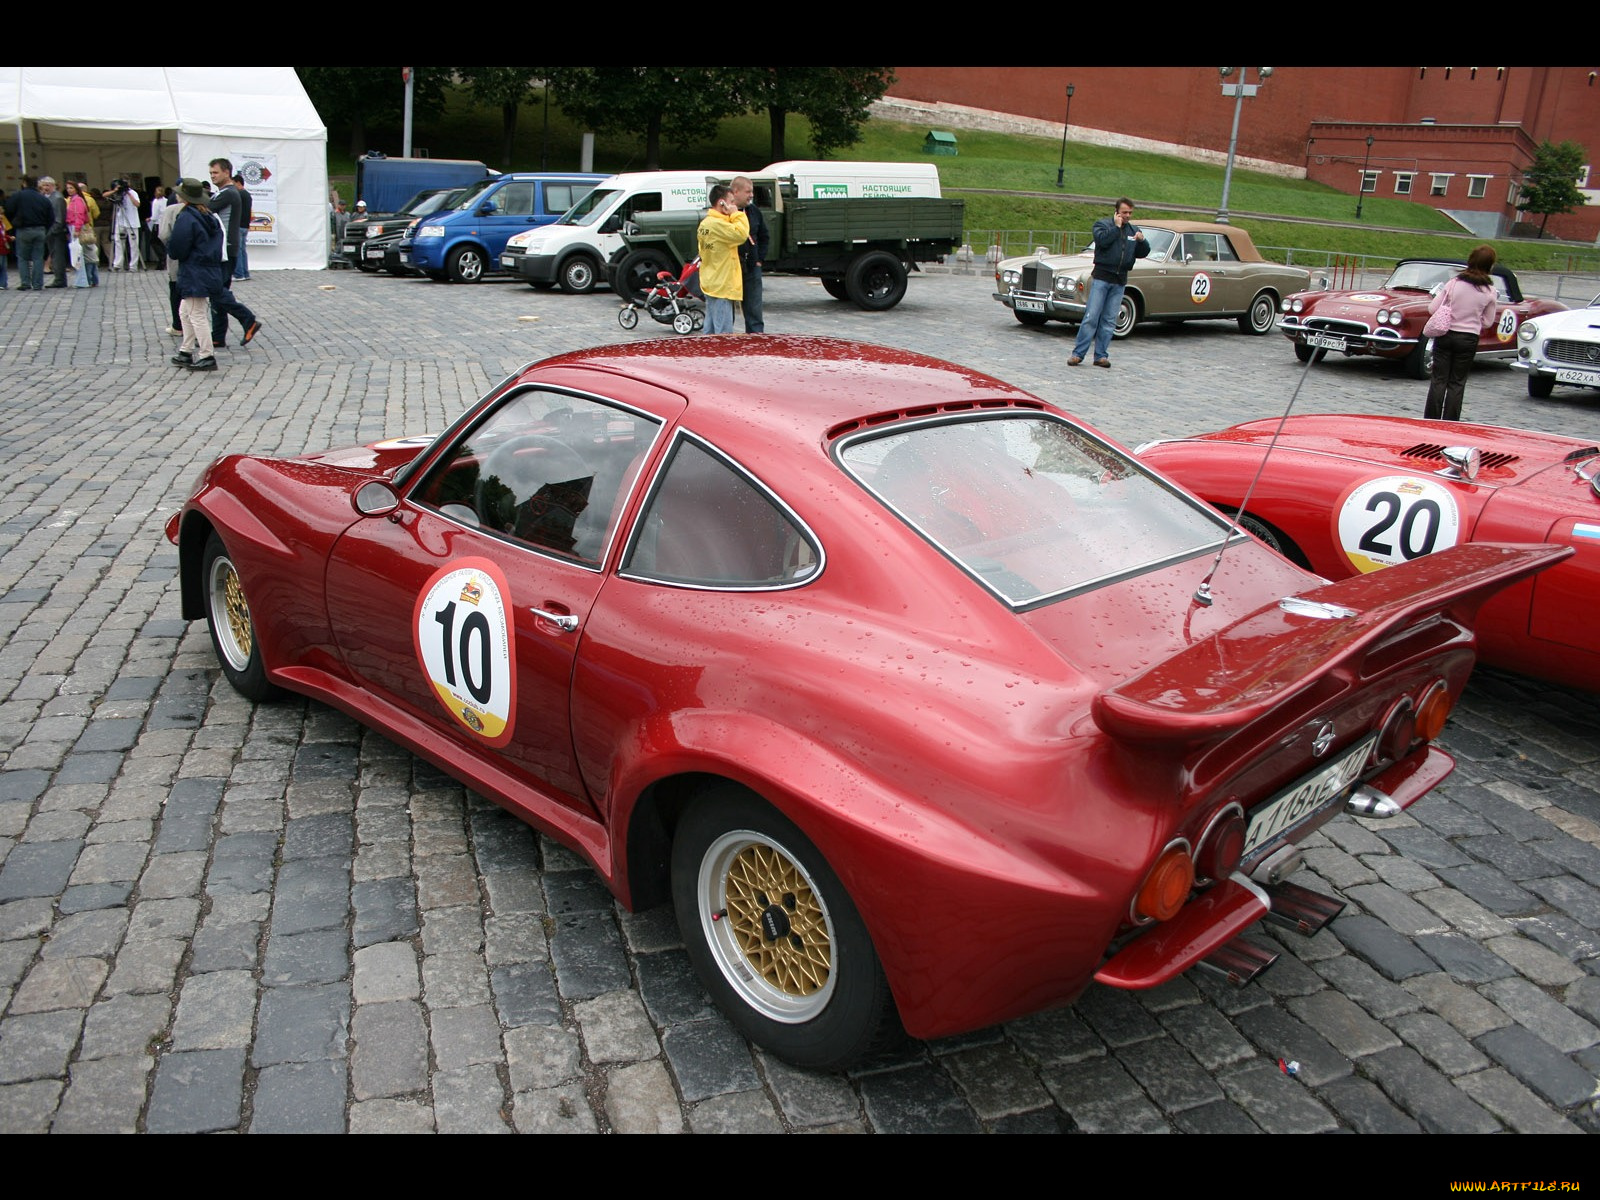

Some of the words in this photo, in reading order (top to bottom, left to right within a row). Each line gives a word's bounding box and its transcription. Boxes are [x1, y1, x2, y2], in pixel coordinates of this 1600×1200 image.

[671, 188, 706, 196] НАСТОЯЩ
[862, 184, 912, 193] НАСТОЯЩИЕ
[1194, 279, 1207, 295] 22
[1501, 316, 1514, 334] 18
[1359, 491, 1441, 560] 20
[435, 600, 492, 705] 10
